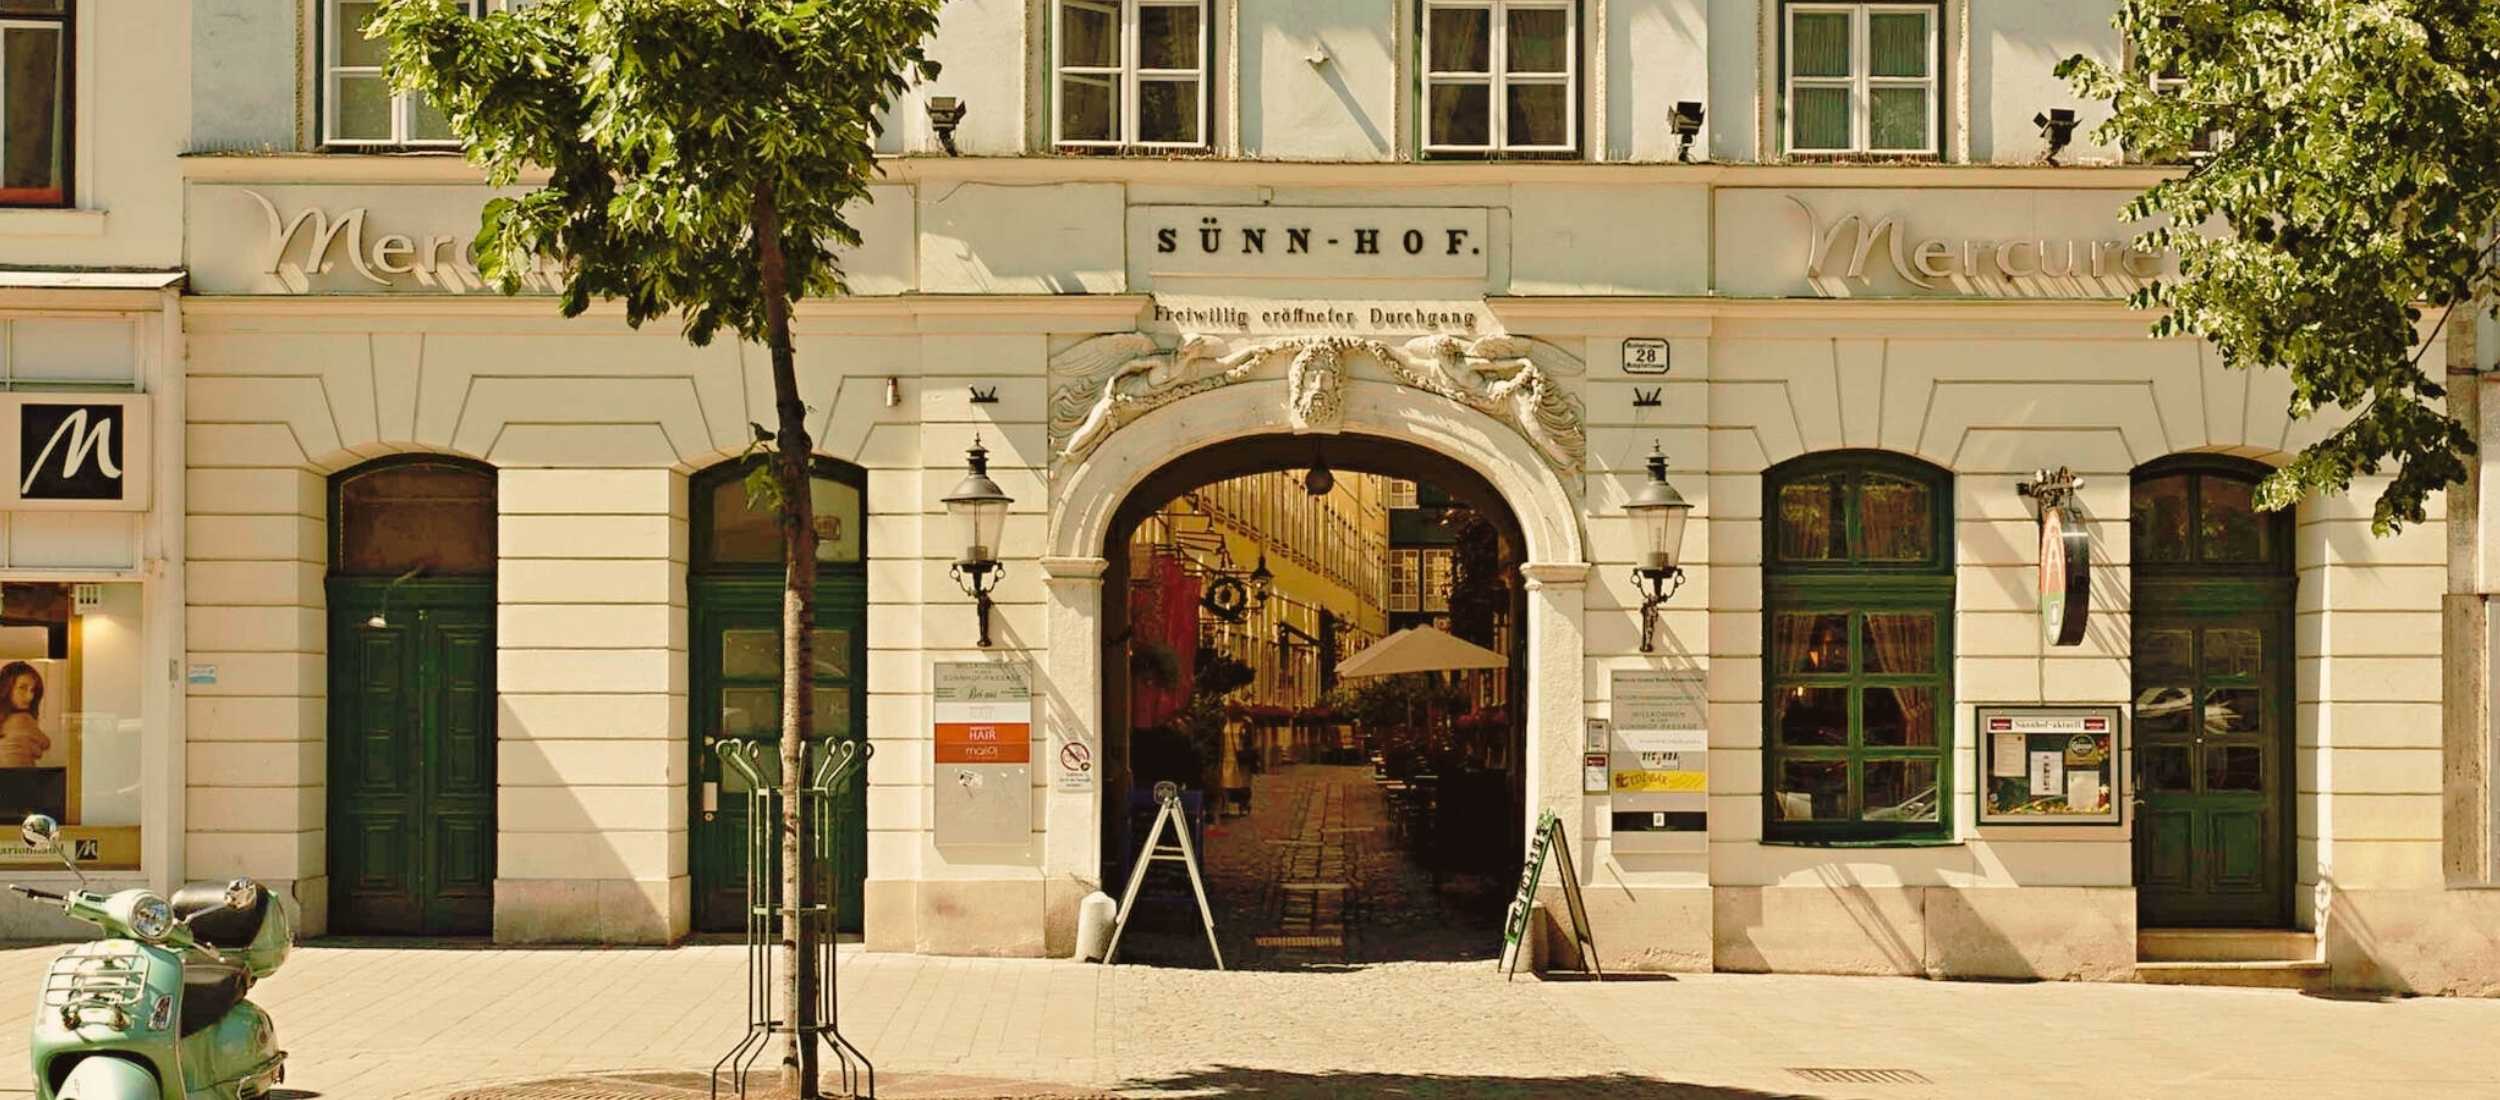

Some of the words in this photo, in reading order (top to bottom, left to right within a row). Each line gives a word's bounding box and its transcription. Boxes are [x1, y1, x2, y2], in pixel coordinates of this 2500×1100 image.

[1785, 194, 2165, 290] Mercure
[1154, 304, 1249, 327] Freiwillig
[1370, 307, 1475, 328] Durchgang
[1636, 348, 1656, 363] 28
[21, 408, 122, 494] M
[969, 729, 998, 741] HAIR
